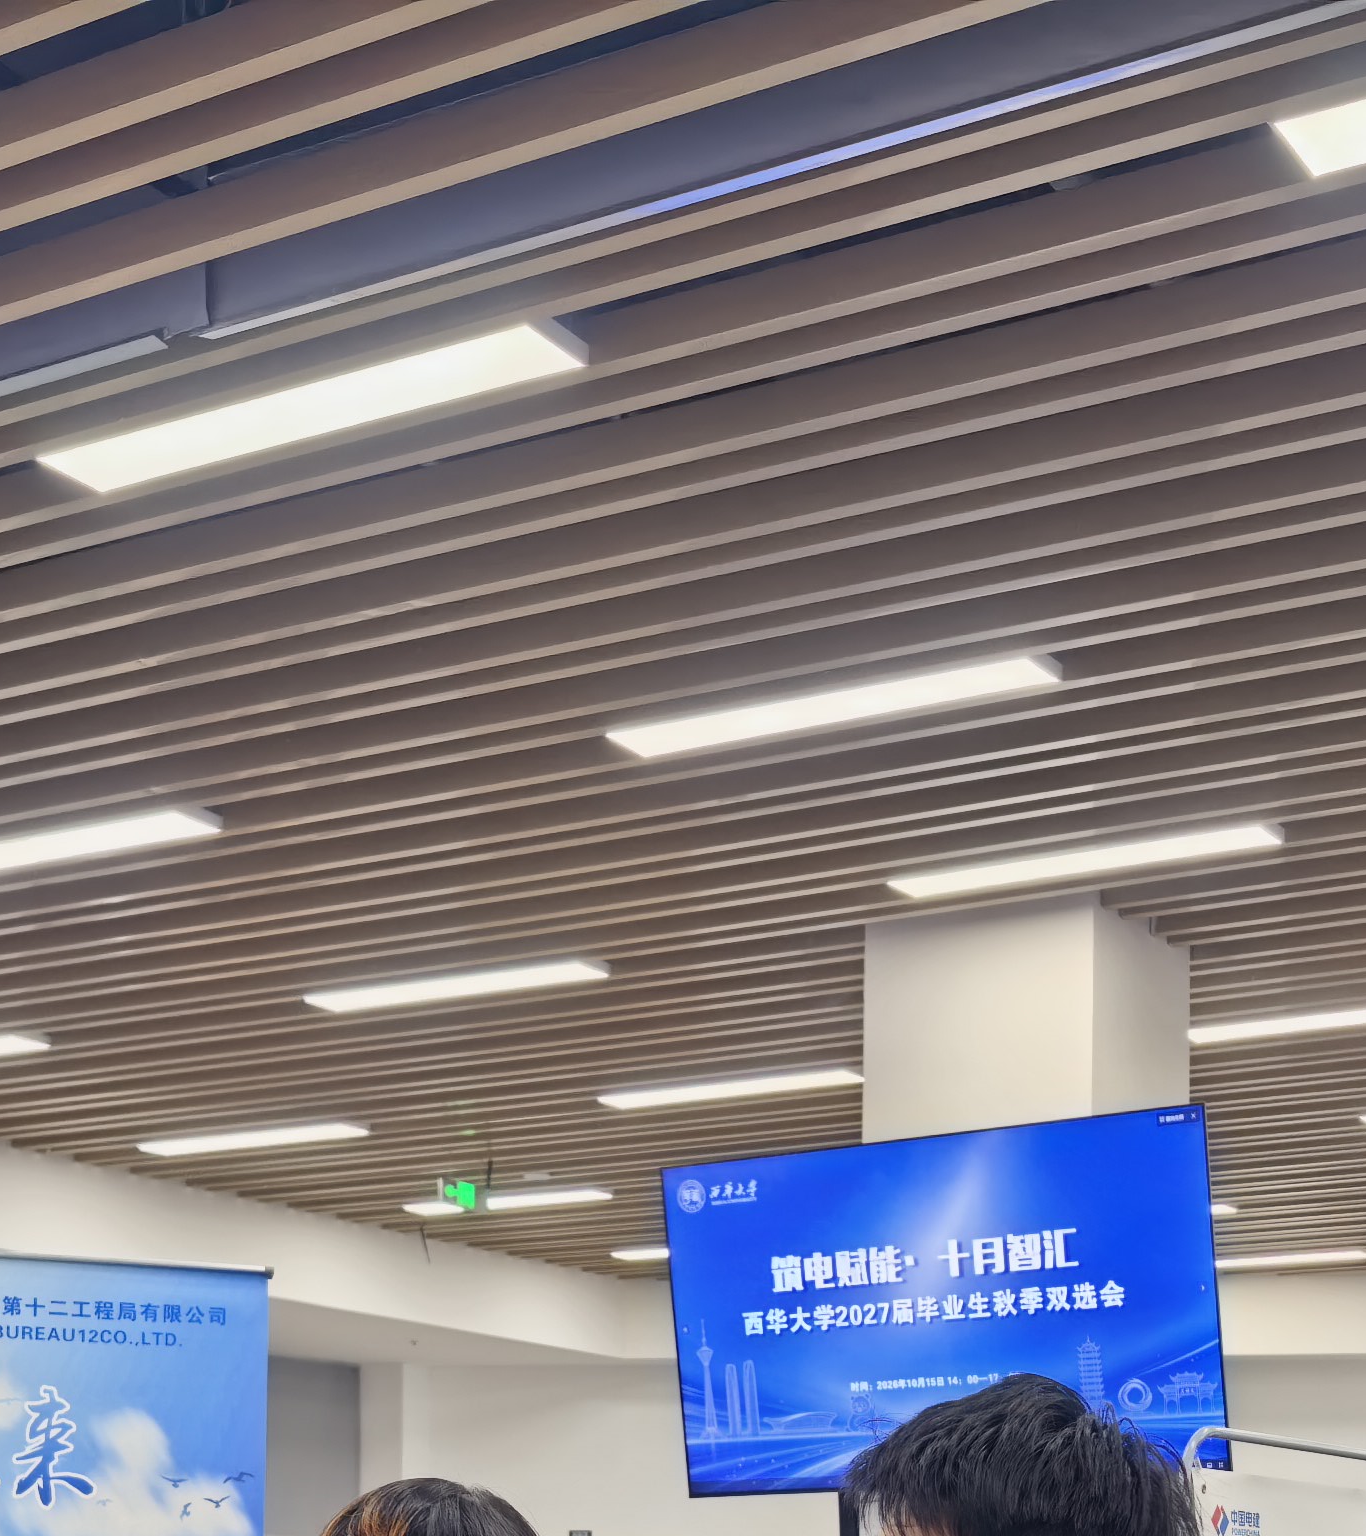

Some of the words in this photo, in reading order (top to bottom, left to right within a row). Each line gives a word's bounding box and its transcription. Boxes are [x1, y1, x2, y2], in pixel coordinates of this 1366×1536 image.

[937, 1227, 1080, 1278] 十月智汇
[741, 1279, 1126, 1337] 西华大学2027届毕业生秋季双选会
[1230, 1509, 1260, 1528] 中国电建
